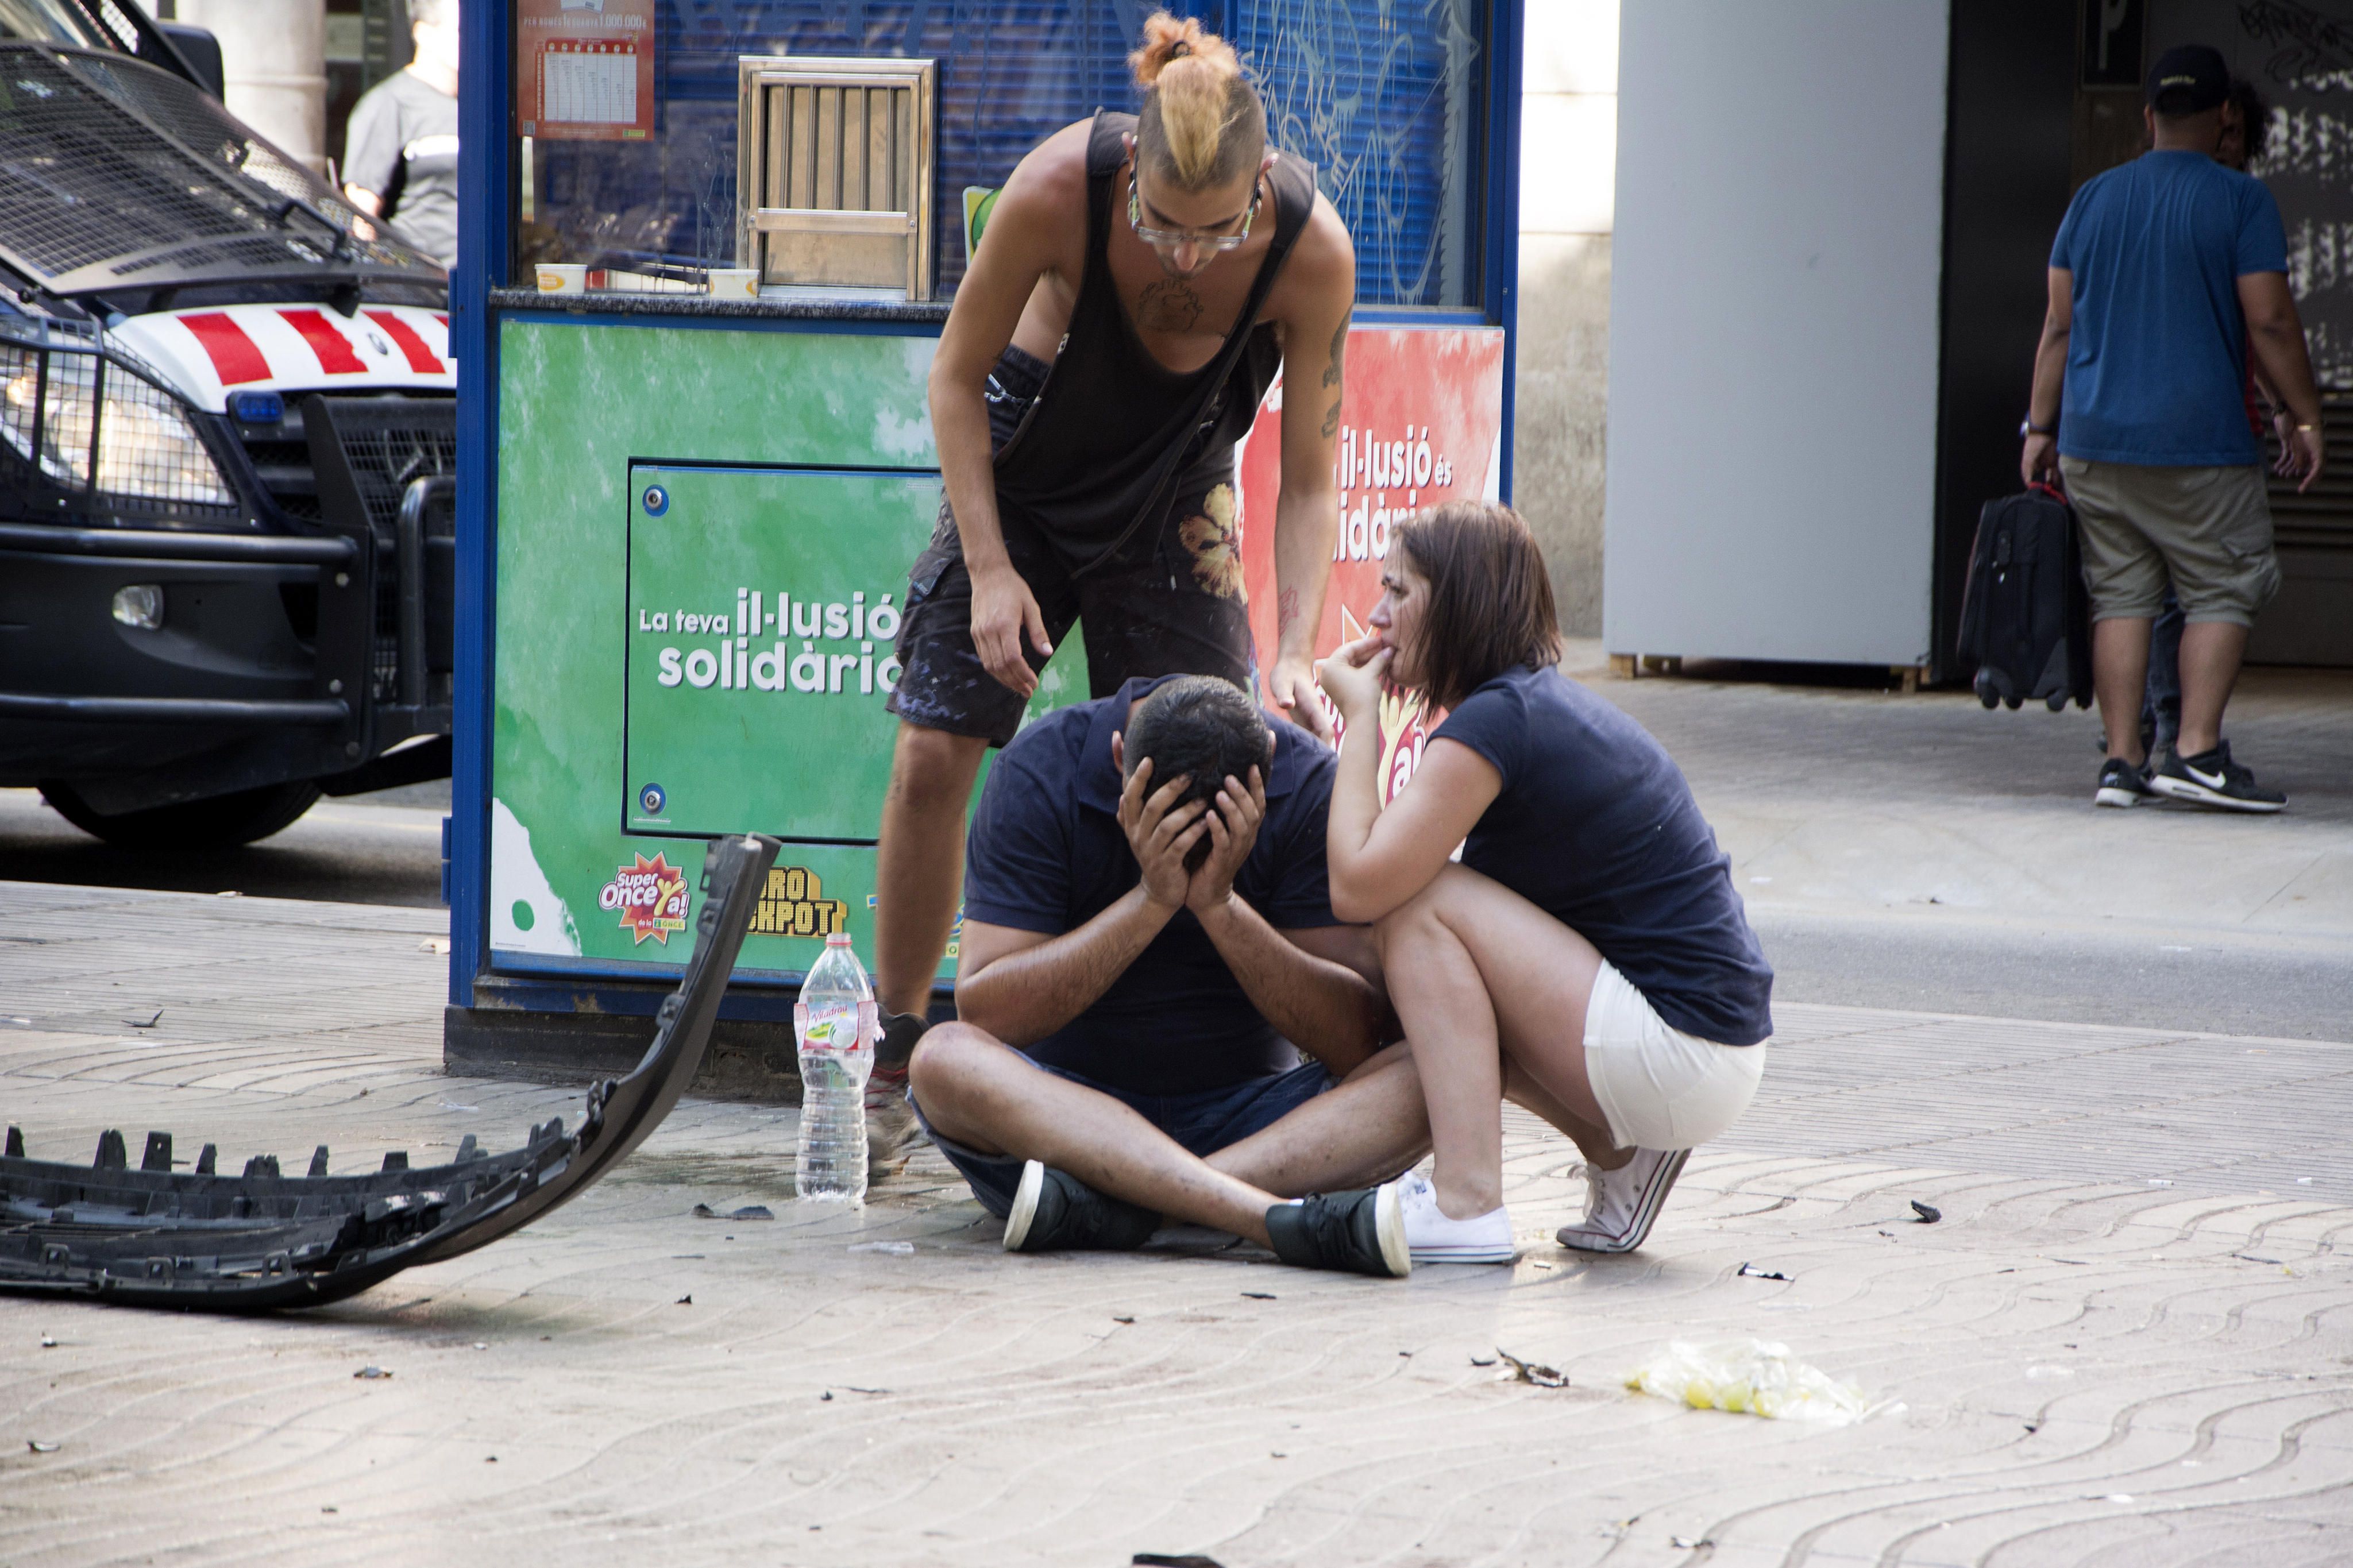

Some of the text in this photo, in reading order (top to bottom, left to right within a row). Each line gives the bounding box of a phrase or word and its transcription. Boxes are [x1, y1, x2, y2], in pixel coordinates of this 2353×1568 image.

[1434, 453, 1452, 487] és
[639, 609, 668, 632] La
[675, 608, 730, 635] teva
[662, 920, 684, 928] ONCE
